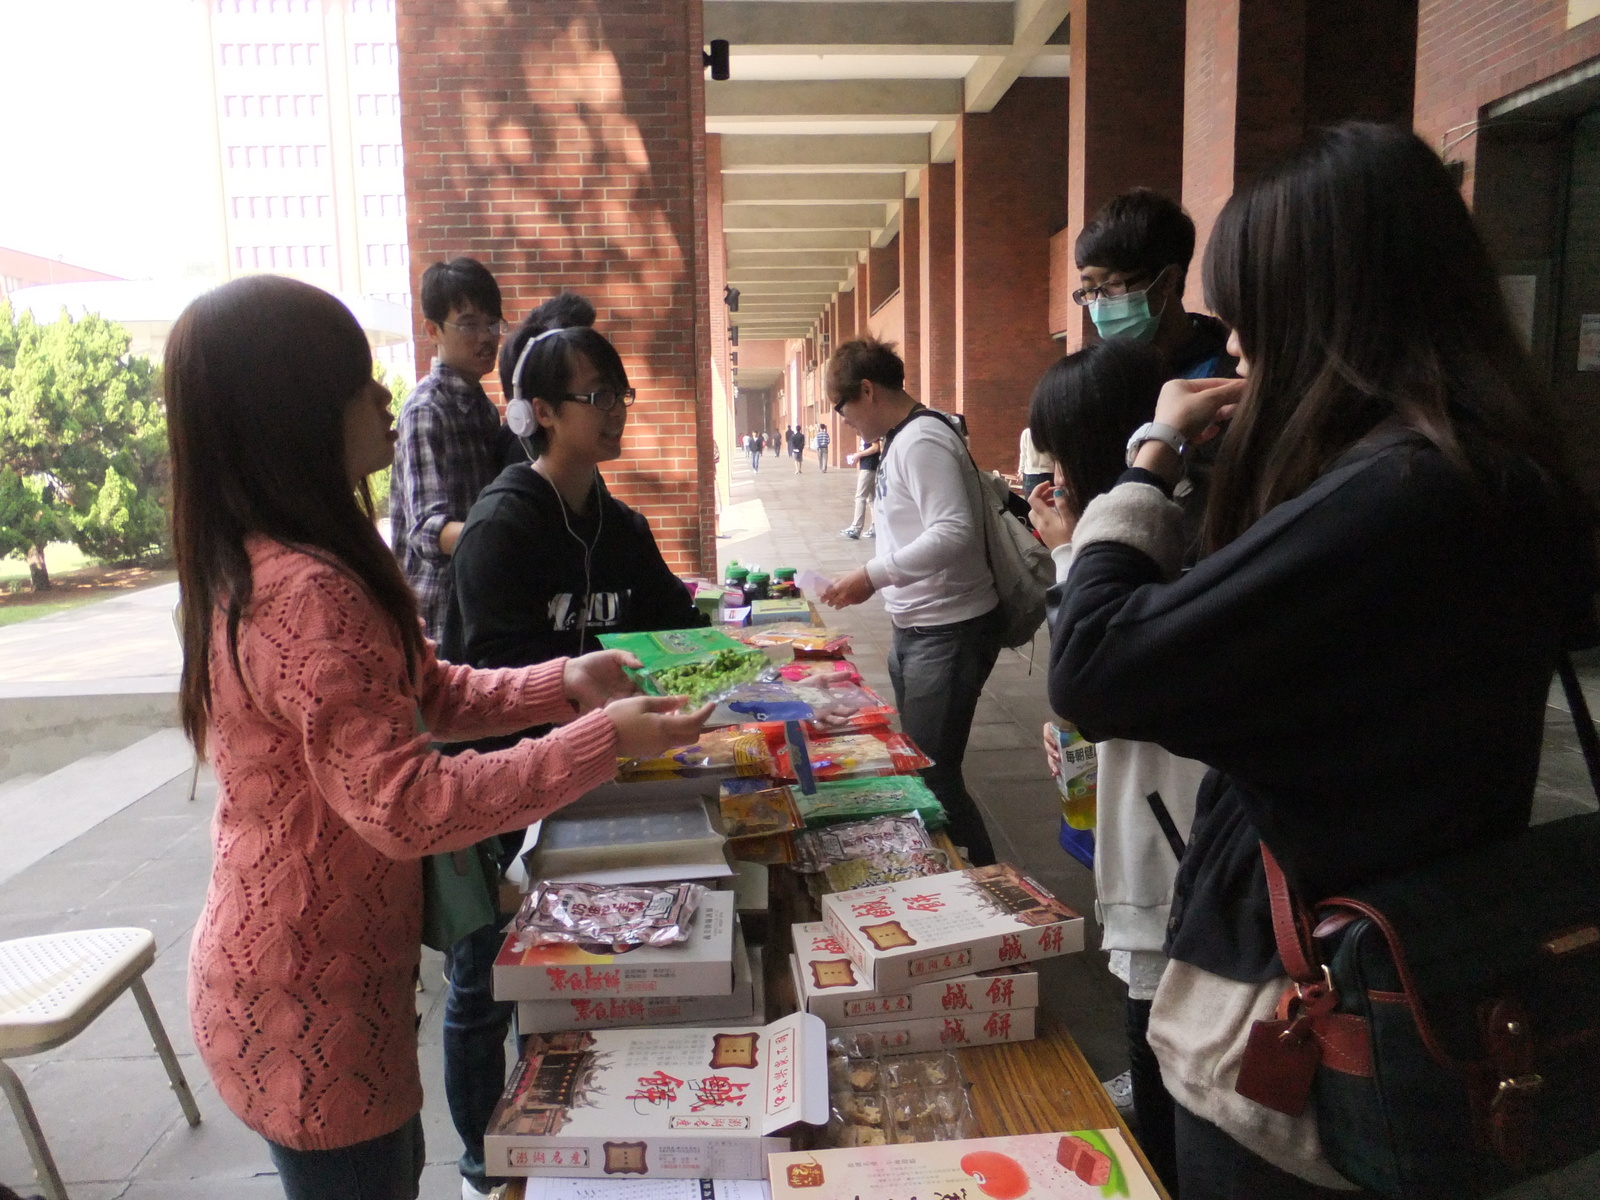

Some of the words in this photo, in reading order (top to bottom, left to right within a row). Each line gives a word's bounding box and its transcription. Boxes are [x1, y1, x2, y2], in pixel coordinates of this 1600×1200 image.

[1066, 744, 1097, 764] 每朝健
[998, 925, 1064, 962] 鹹餅
[941, 978, 1014, 1011] 鹹餅
[939, 1012, 1012, 1044] 鹹餅
